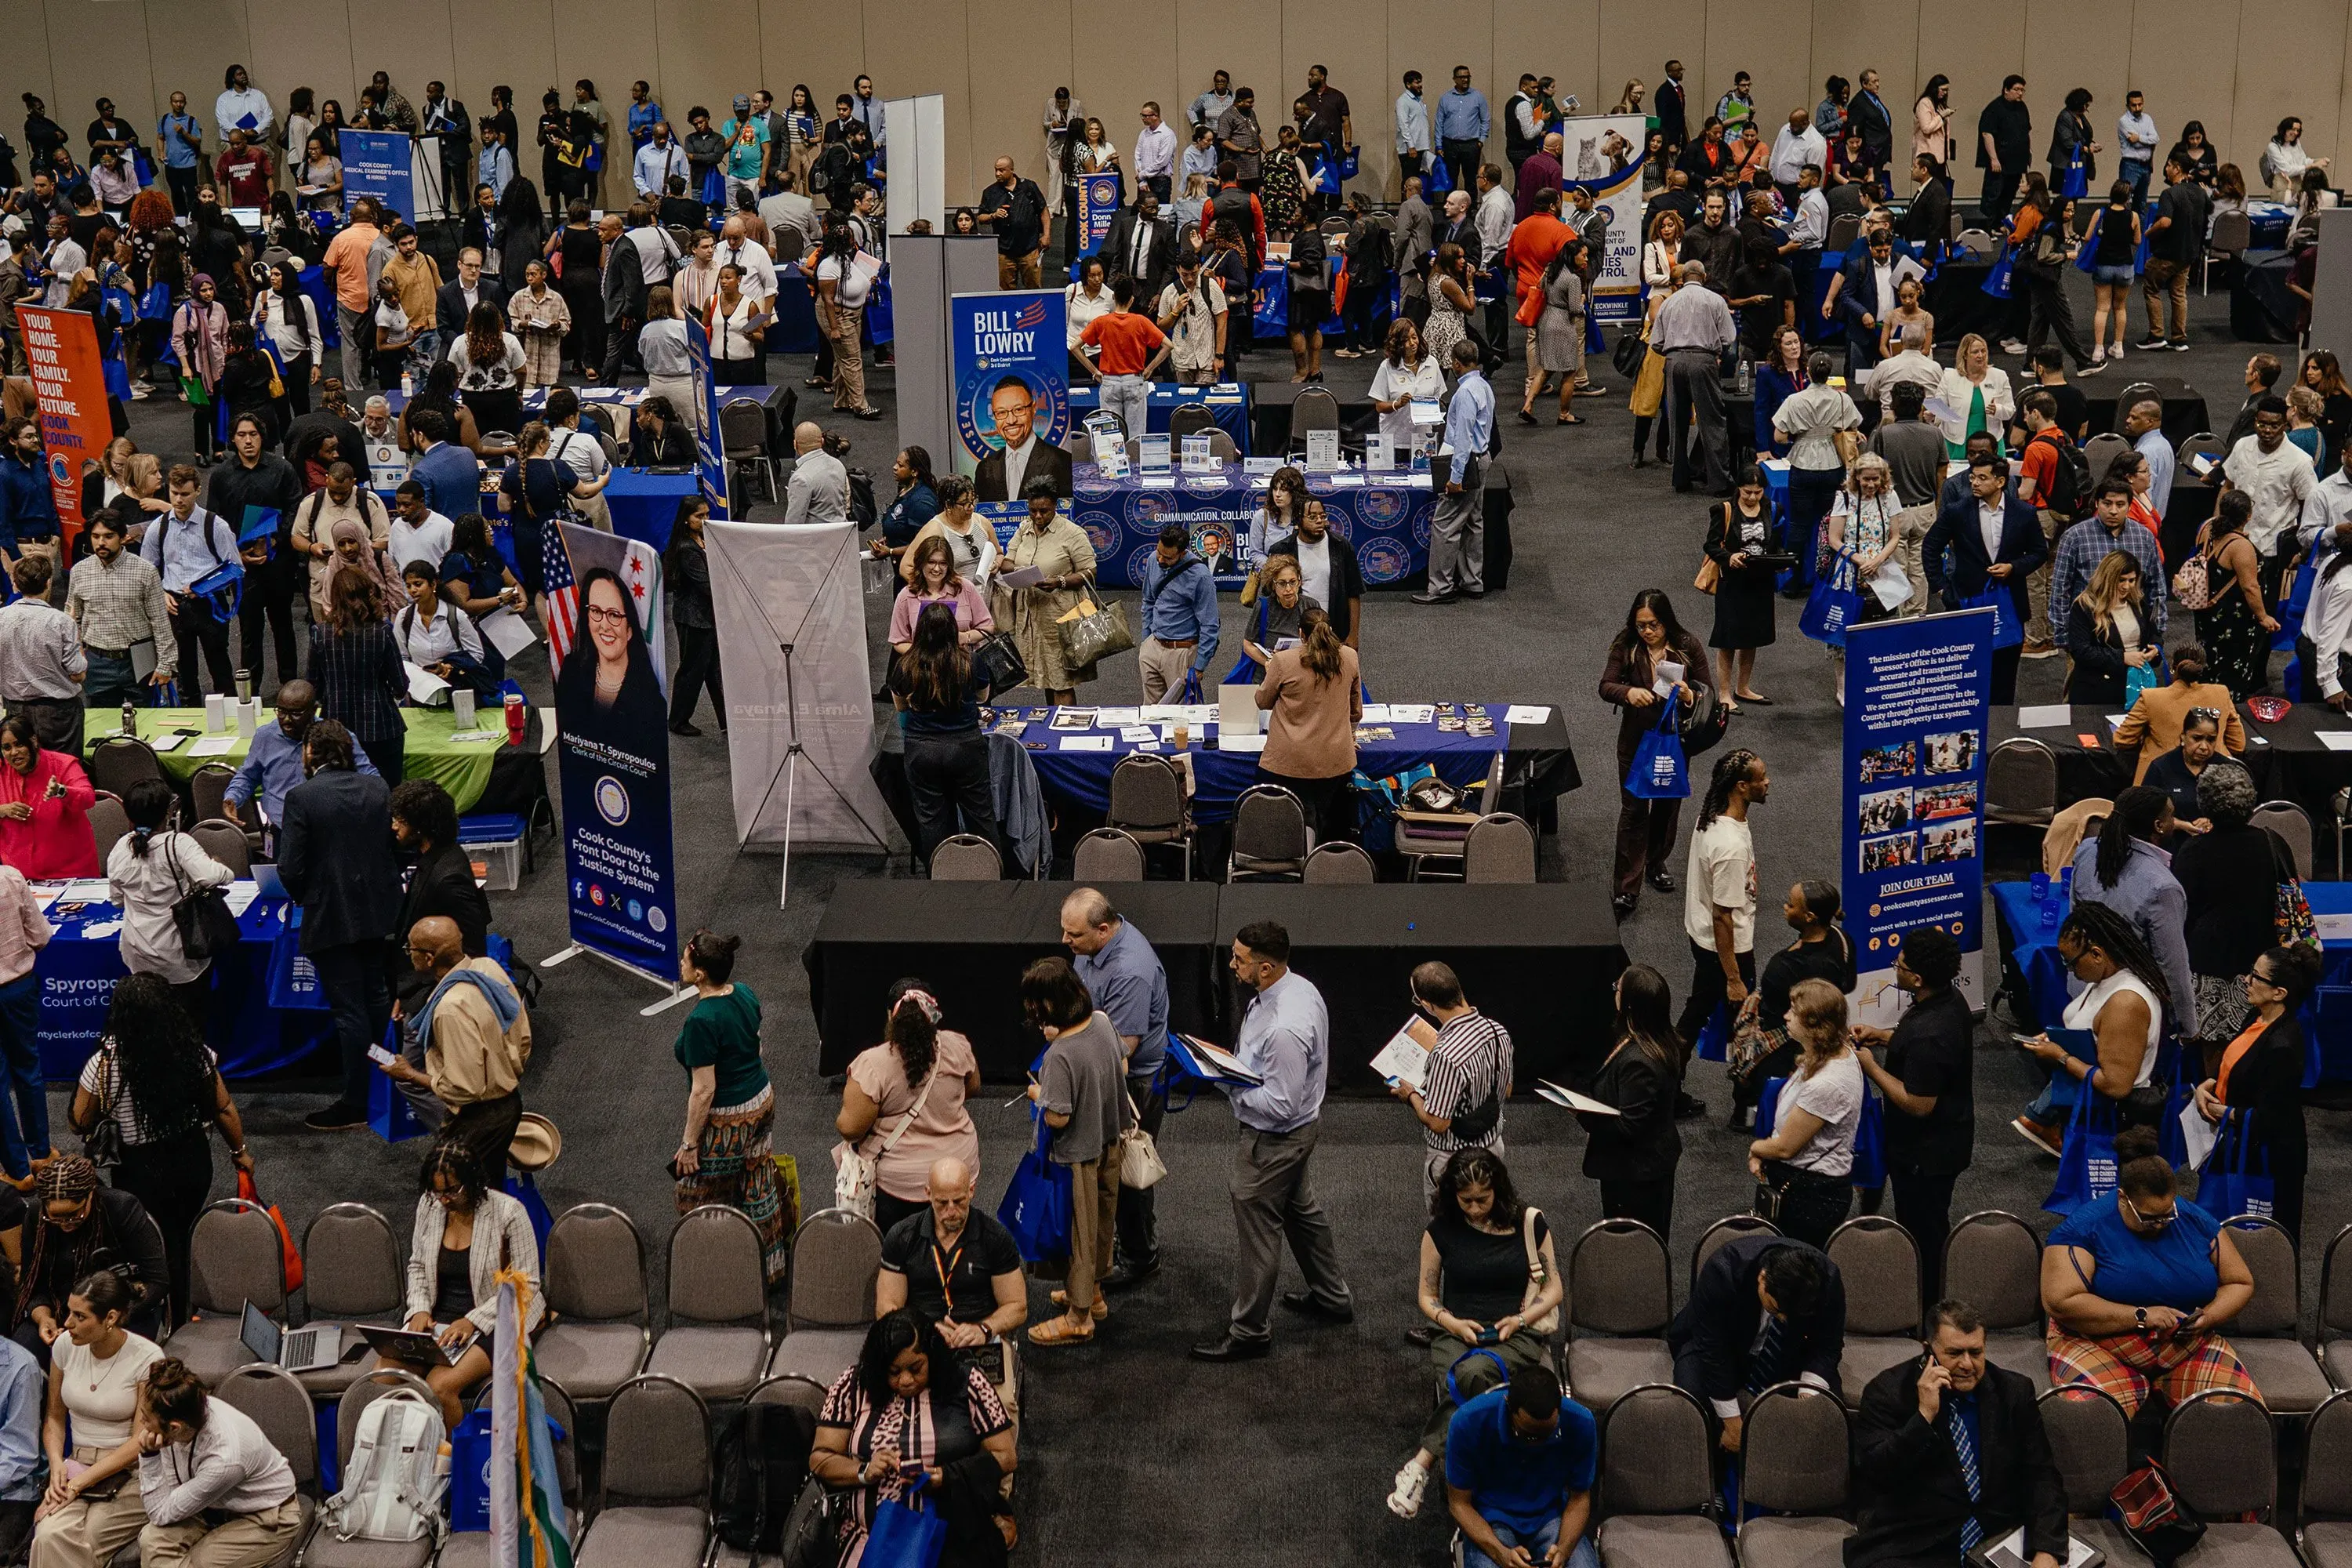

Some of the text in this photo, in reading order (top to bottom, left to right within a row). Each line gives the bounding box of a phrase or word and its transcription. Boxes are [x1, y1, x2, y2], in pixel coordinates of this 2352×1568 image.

[1079, 178, 1088, 220] COUNTY
[1080, 220, 1089, 250] COOK
[1613, 246, 1636, 256] AND
[24, 314, 52, 331] YOUR
[974, 310, 1011, 332] BILL
[28, 330, 61, 348] HOME.
[975, 331, 1035, 354] LOWRY
[30, 347, 58, 364] YOUR
[33, 364, 71, 383] FAMILY.
[36, 380, 64, 397] YOUR
[39, 397, 80, 417] FUTURE.
[42, 414, 69, 430] COOK
[961, 401, 975, 439] SEAL
[45, 431, 85, 449] COUNTY.
[1154, 511, 1220, 522] COMMUNICATION.
[1883, 653, 1910, 662] mission
[1932, 646, 1949, 655] Cook
[1949, 643, 1975, 652] County
[1872, 662, 1908, 673] Assessor's
[1910, 659, 1929, 667] Office
[1946, 653, 1969, 662] deliver
[1879, 663, 1962, 681] accurate and transparent
[1865, 670, 1977, 693] assessments of all residential and
[1882, 683, 1958, 700] commercial properties.
[1861, 698, 1980, 721] County through ethical stewardship
[1878, 702, 1896, 710] serve
[1897, 699, 1915, 707] every
[1915, 693, 1955, 704] community
[1963, 689, 1976, 698] the
[1867, 721, 1891, 730] within
[1903, 715, 1932, 726] property
[1944, 709, 1971, 720] system.
[563, 731, 656, 770] Mariyana T. Spyropoulos
[572, 746, 588, 757] Clerk
[596, 754, 607, 764] the
[608, 757, 629, 771] Circuit
[629, 765, 648, 778] Court
[579, 827, 651, 864] Cook County's
[572, 839, 660, 881] Front Door to the
[579, 855, 655, 894] Justice System
[1880, 872, 1954, 895] JOIN OUR TEAM
[1883, 891, 1963, 911] cookcountyassessor.com
[574, 908, 666, 952] www.CookCountyClerkofCourt.org
[1870, 924, 1893, 933] Connect
[1926, 913, 1943, 923] social
[1944, 910, 1963, 920] media
[45, 977, 118, 993] Spyropo
[42, 996, 80, 1007] Court
[83, 996, 97, 1006] of
